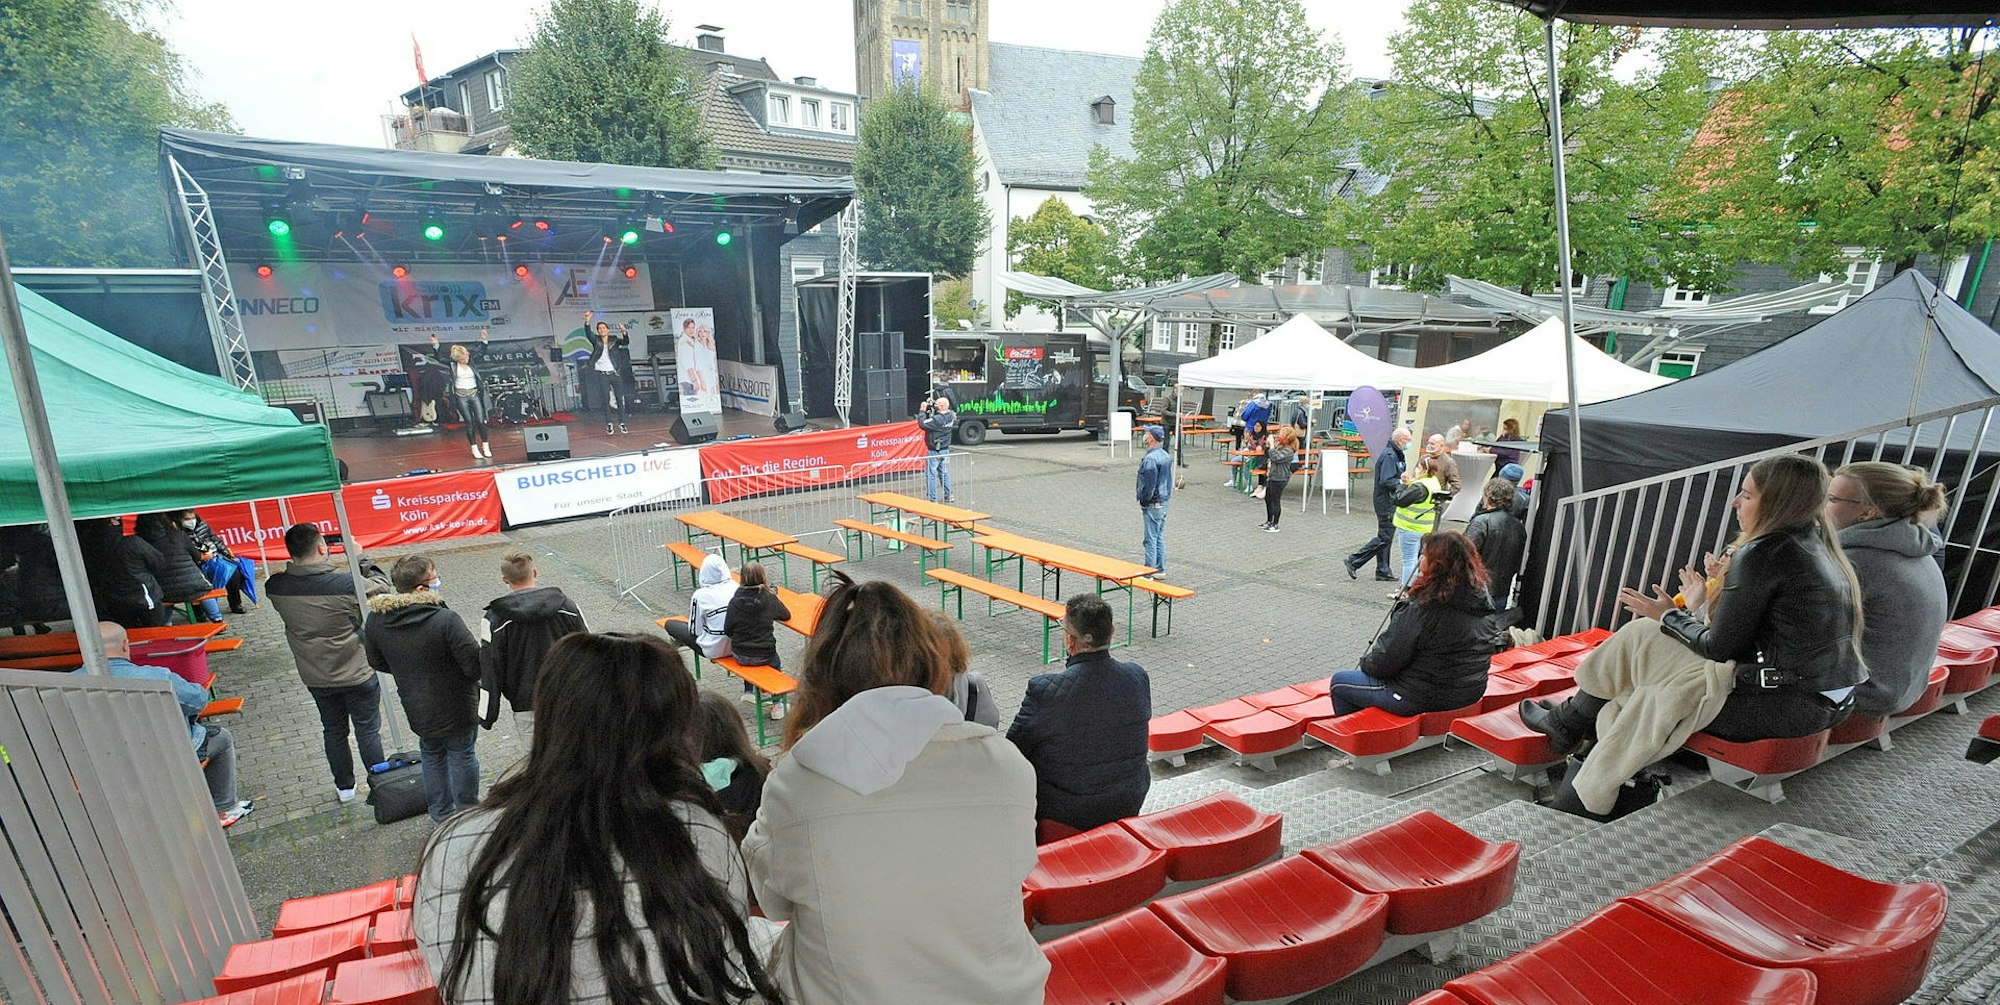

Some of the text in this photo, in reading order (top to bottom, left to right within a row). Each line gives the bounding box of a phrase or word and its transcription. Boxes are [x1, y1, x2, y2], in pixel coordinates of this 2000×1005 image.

[391, 286, 499, 318] krix FM
[762, 461, 780, 473] die
[783, 455, 828, 471] Region.
[517, 462, 637, 491] BURSCHEID
[397, 490, 489, 508] Kreissparkasse
[617, 490, 645, 501] Stadt
[400, 510, 430, 522] Köln
